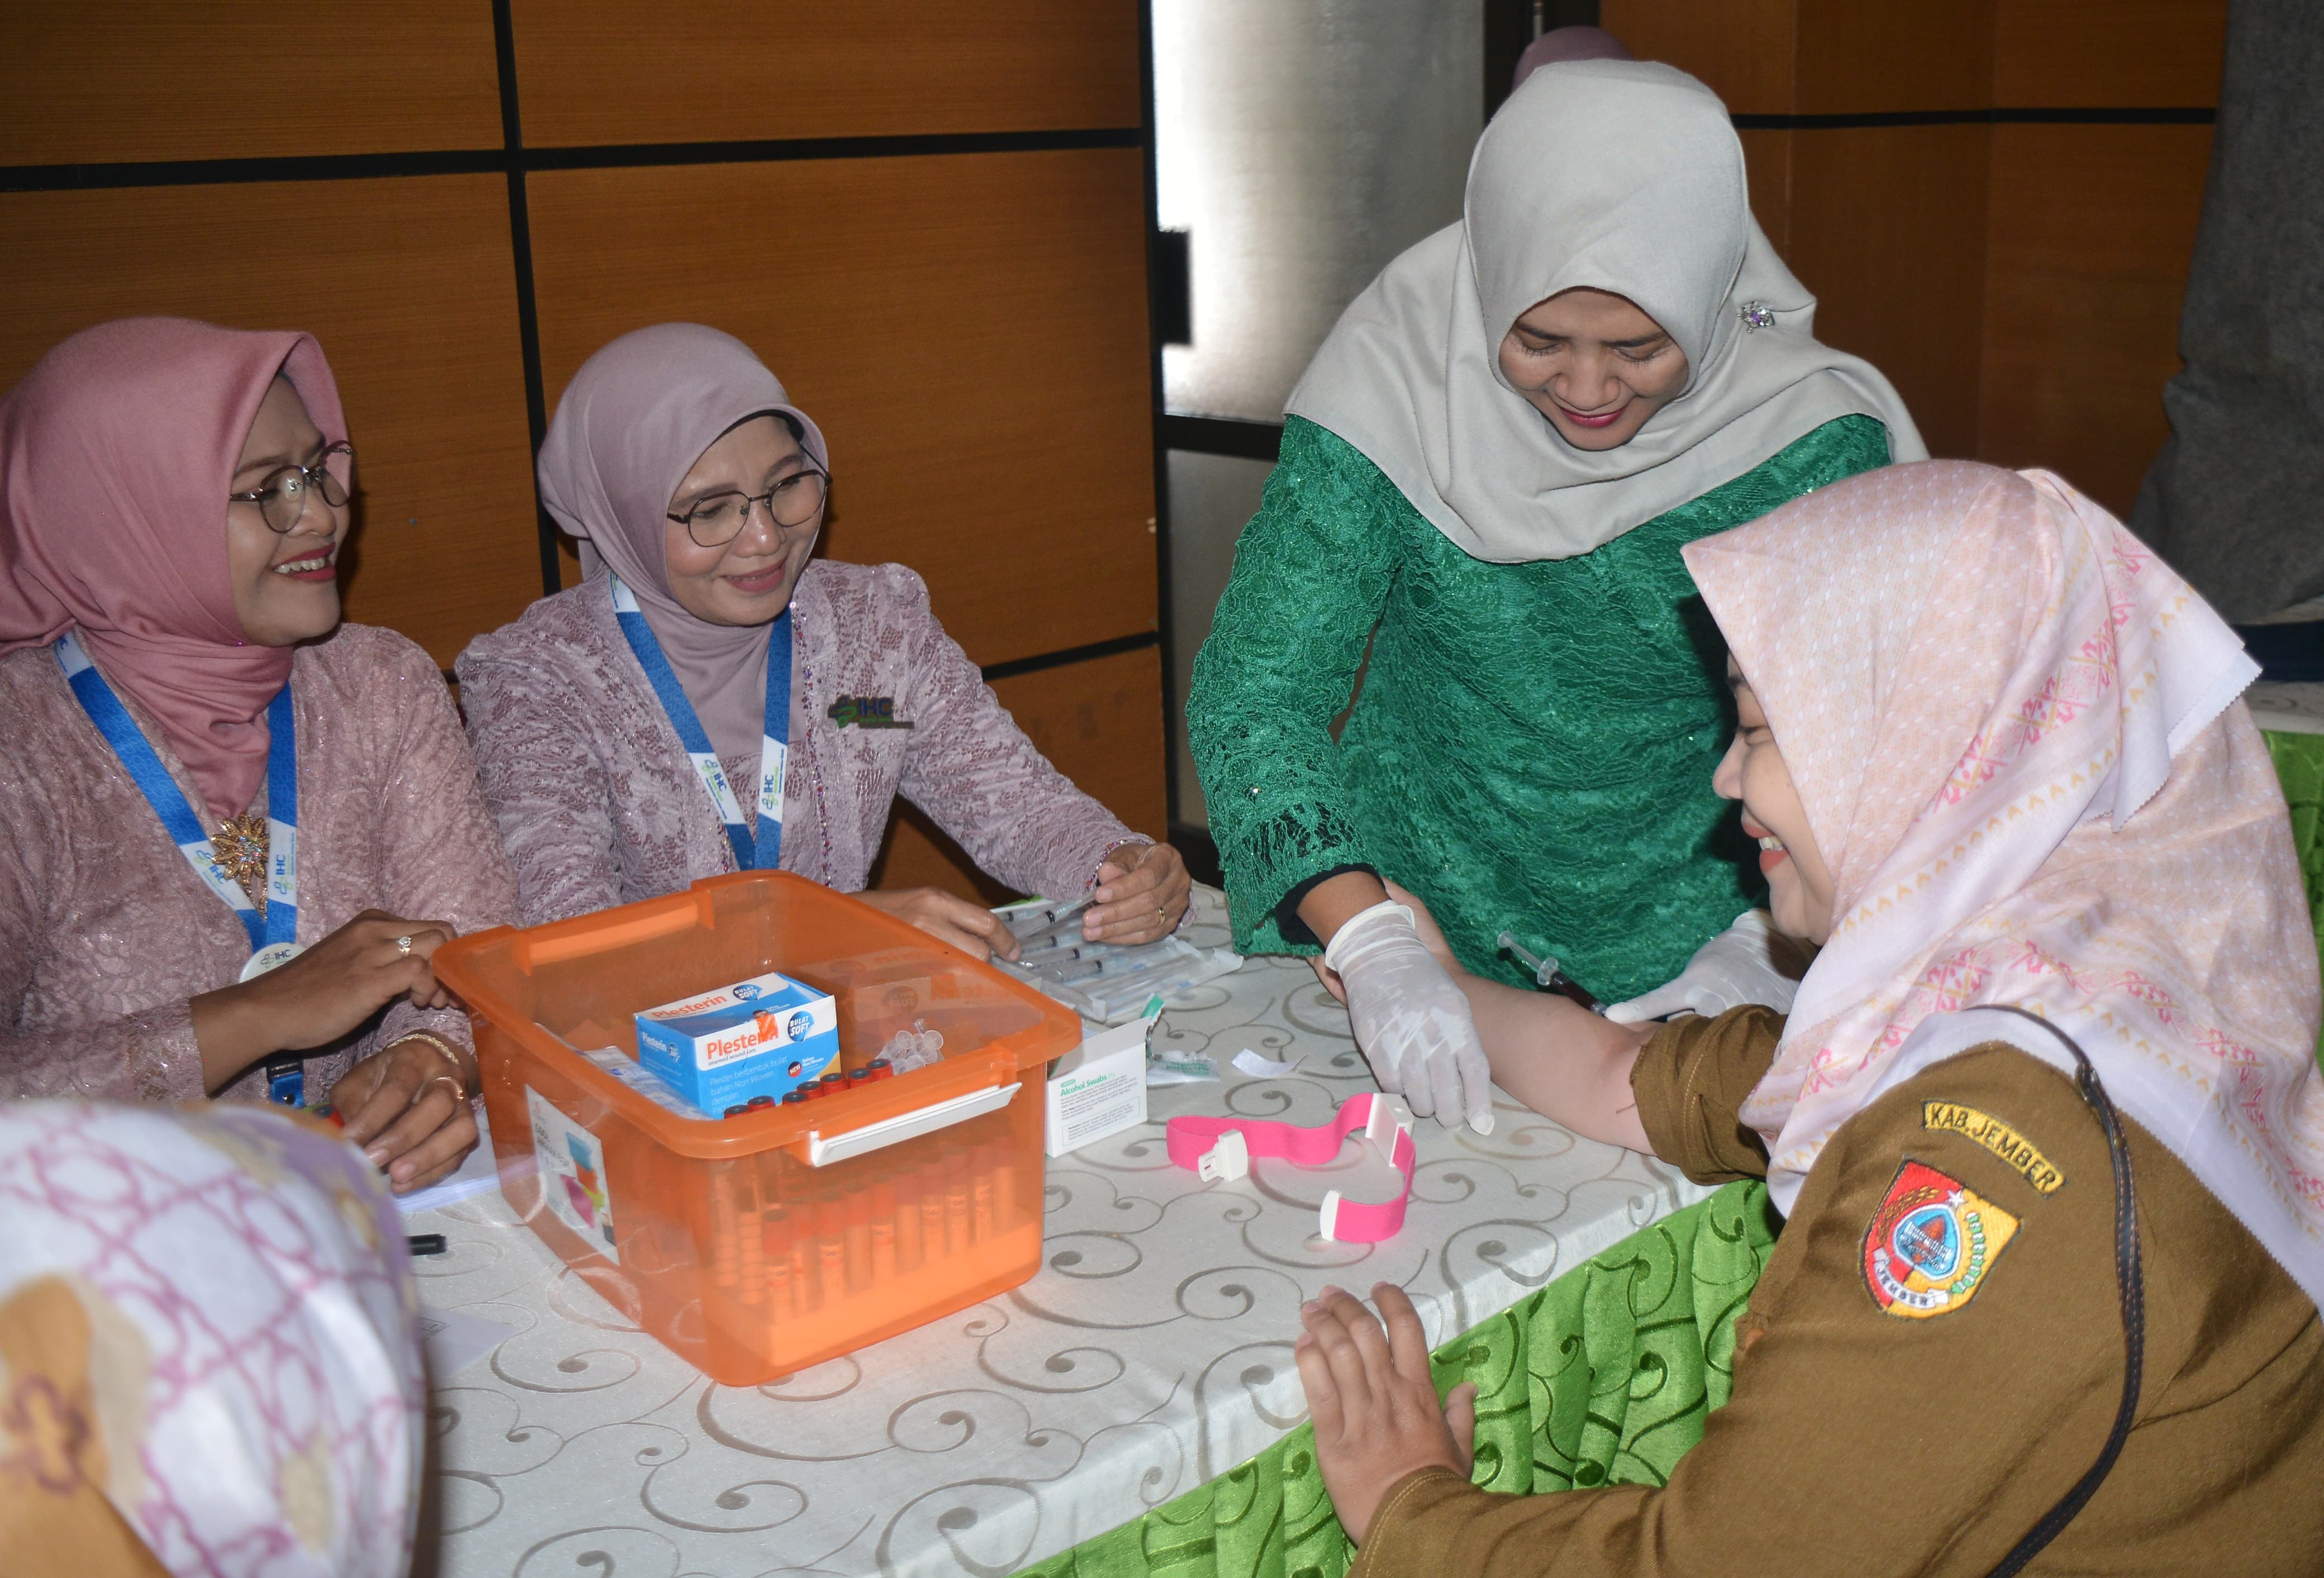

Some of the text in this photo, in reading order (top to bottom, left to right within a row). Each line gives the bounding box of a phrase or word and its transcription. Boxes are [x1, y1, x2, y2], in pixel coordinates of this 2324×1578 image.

[858, 699, 893, 716] IHC
[713, 772, 727, 792] IHC
[763, 774, 774, 793] IHC
[275, 854, 286, 875] IHC
[275, 949, 291, 960] IHC
[734, 985, 754, 995] BULAT
[739, 989, 759, 999] SOFT
[652, 995, 728, 1017] Plesterin
[789, 1015, 809, 1027] BULAT
[790, 1022, 810, 1037] SOFT
[730, 1051, 746, 1060] wound
[789, 1064, 801, 1075] NEW
[1060, 1082, 1085, 1097] Alcohol
[1087, 1075, 1107, 1087] Swabs
